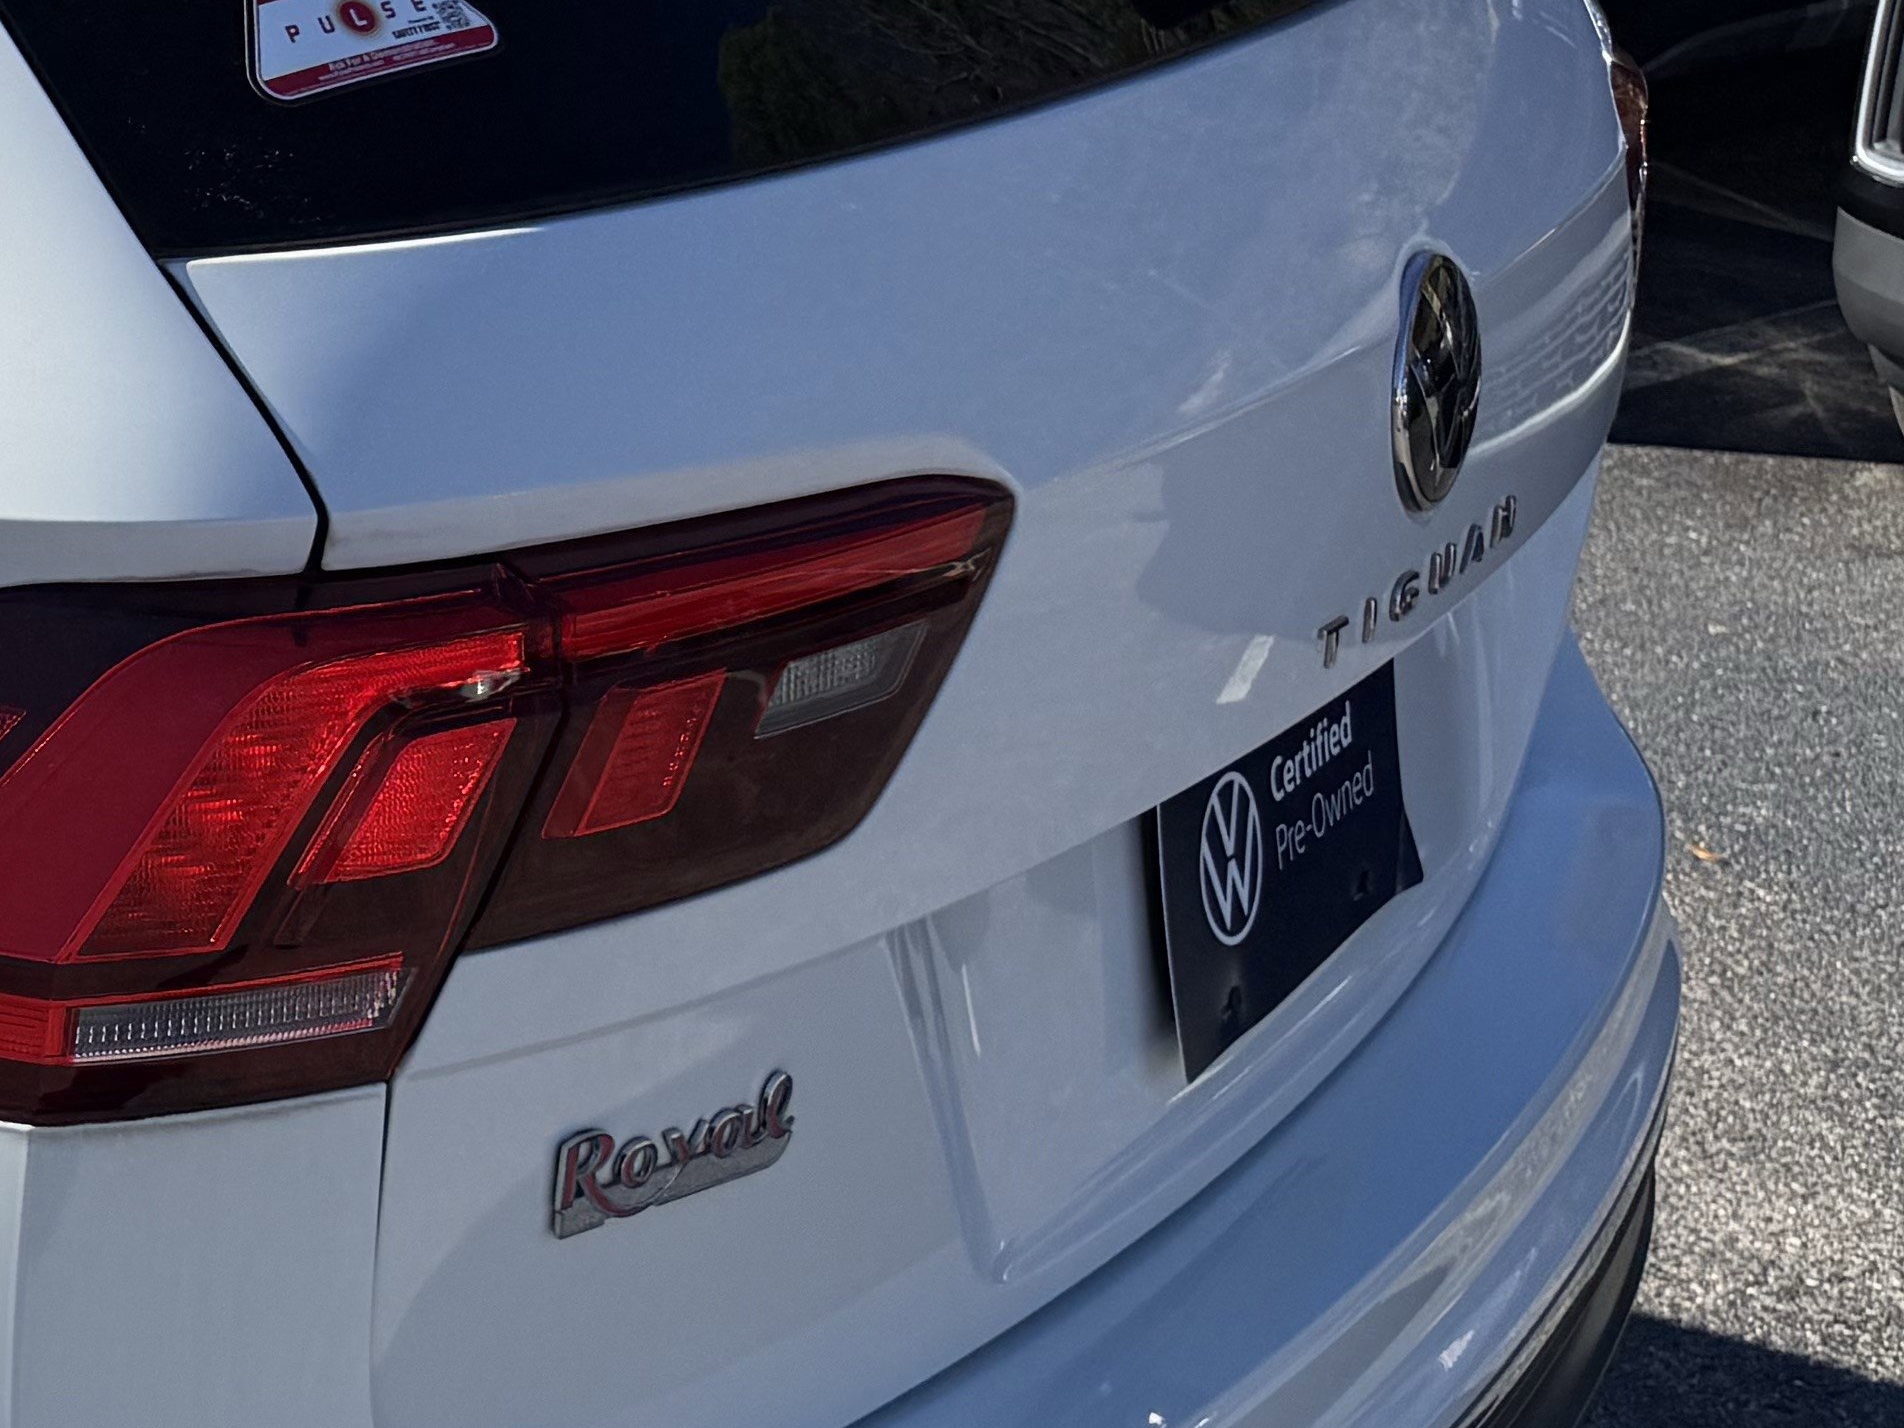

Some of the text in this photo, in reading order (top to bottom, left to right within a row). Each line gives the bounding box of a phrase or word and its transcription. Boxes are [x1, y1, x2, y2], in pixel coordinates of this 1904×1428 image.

[1316, 493, 1518, 670] TIGUAN
[1270, 700, 1353, 802] Certified
[1275, 750, 1375, 870] Pre-Owned
[552, 1070, 795, 1222] Royal
